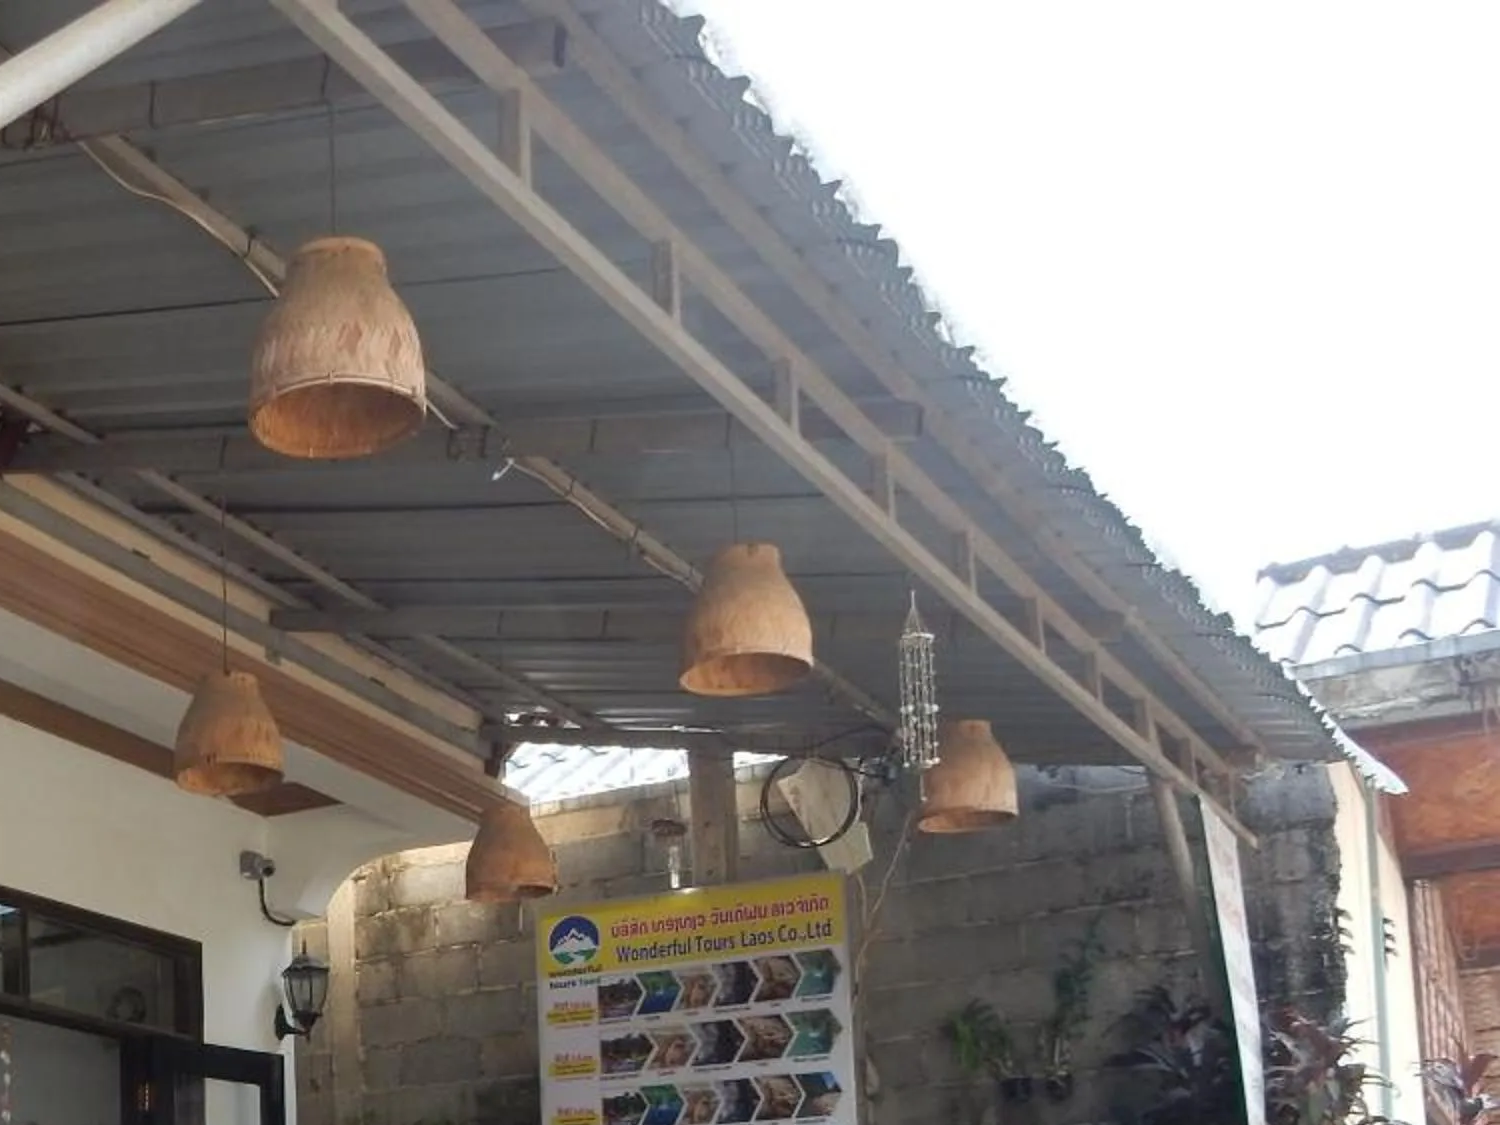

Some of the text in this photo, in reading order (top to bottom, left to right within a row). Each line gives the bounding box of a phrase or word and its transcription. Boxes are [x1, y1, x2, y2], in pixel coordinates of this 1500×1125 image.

[616, 936, 691, 962] Wonderful
[695, 934, 736, 953] Tours
[740, 930, 775, 947] Laos
